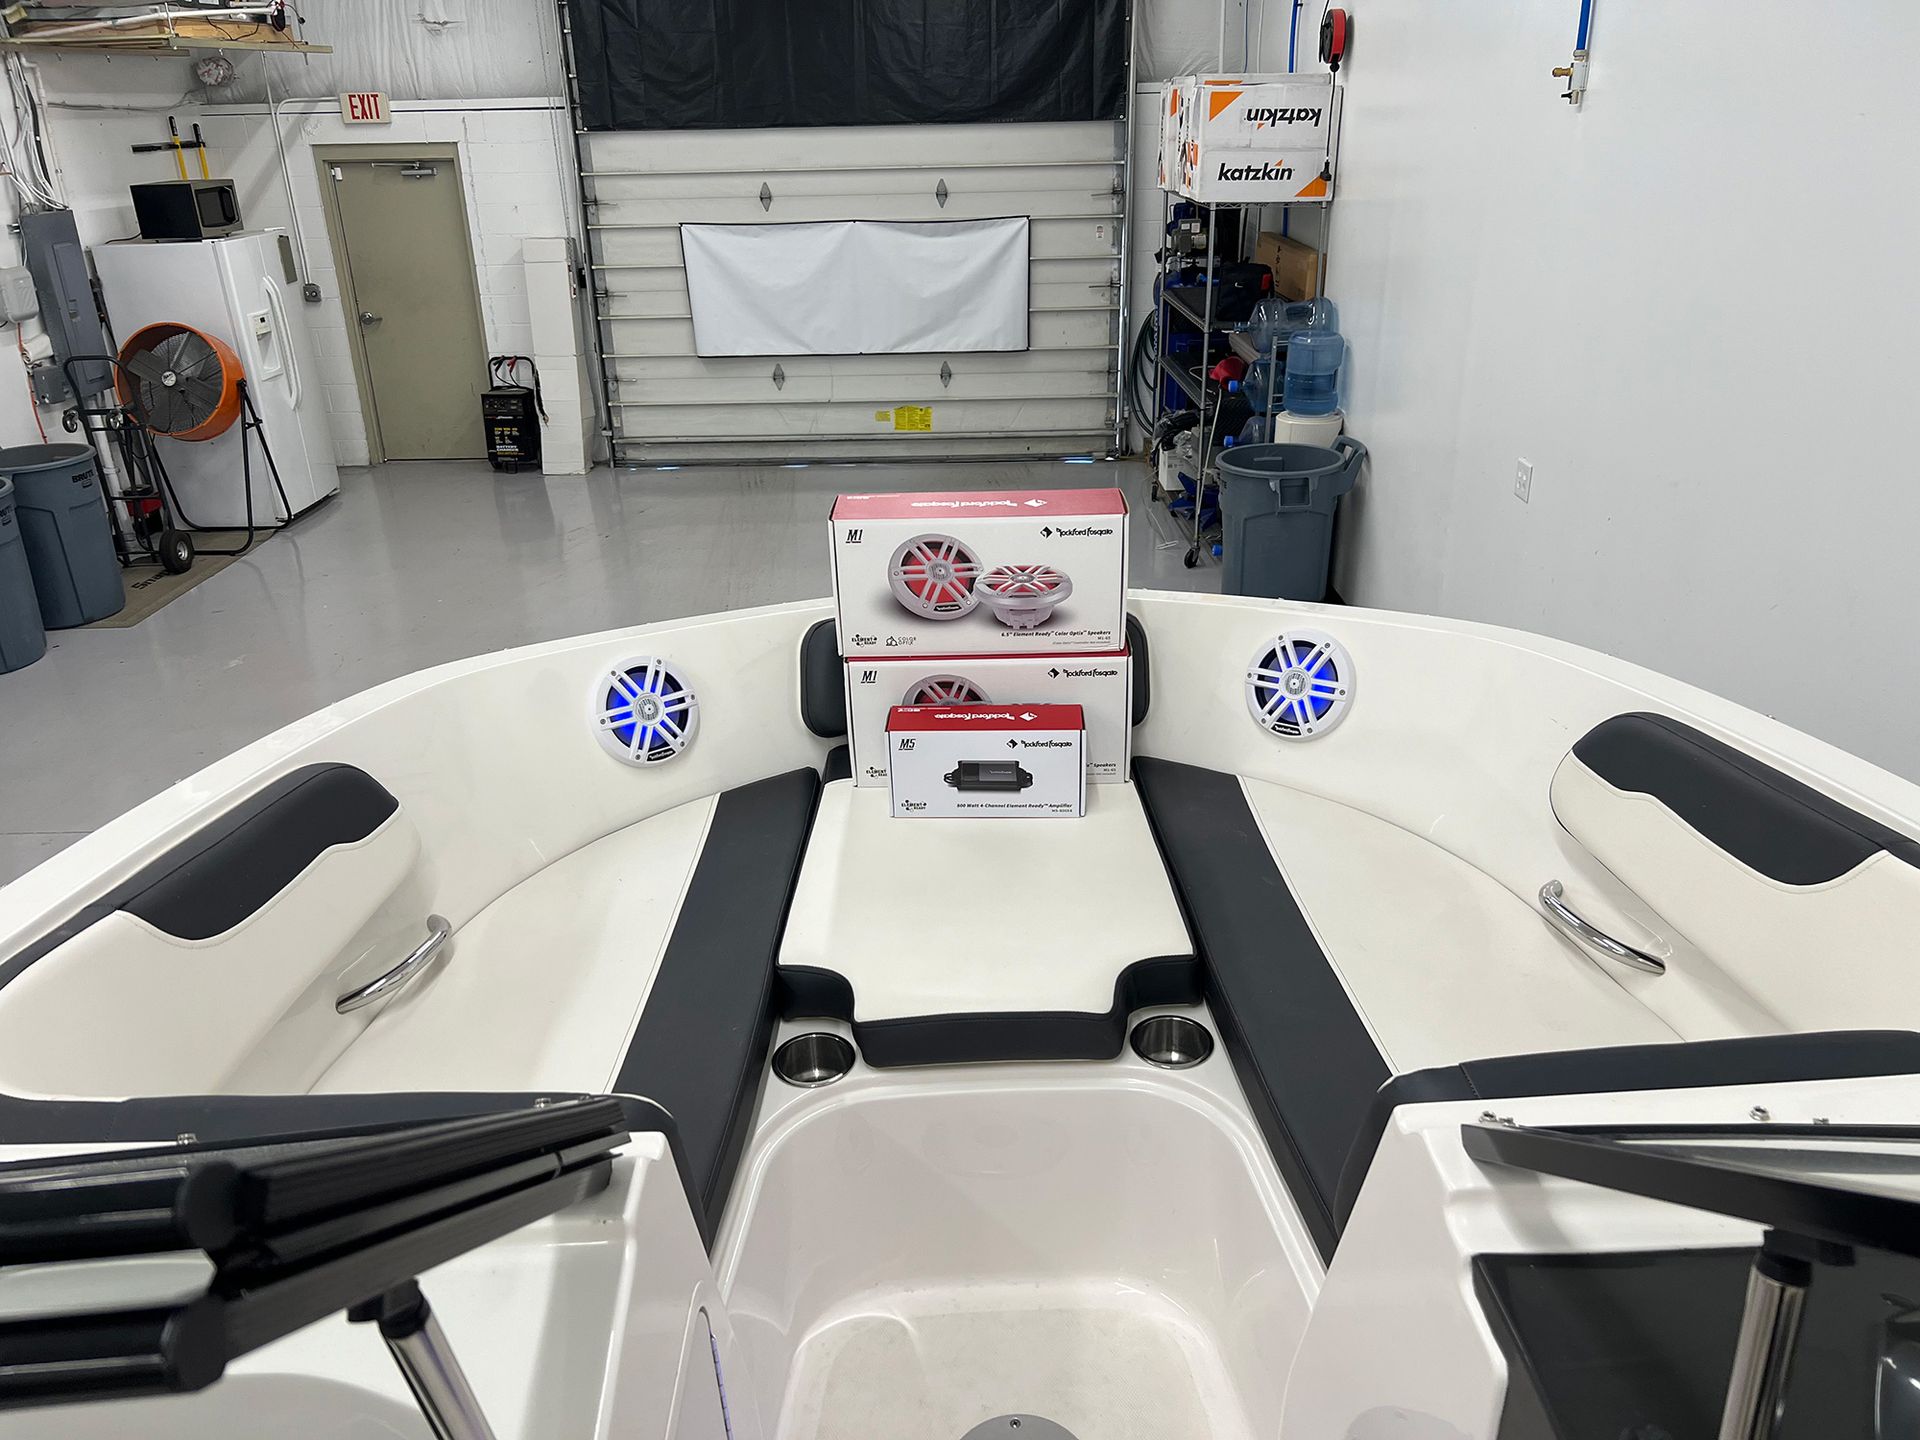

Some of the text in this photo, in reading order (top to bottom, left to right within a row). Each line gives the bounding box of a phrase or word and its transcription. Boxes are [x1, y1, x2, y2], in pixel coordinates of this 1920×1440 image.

[348, 94, 380, 119] EXIT
[1246, 108, 1322, 130] katzkin
[1217, 159, 1293, 181] katzkin
[846, 529, 863, 543] M1
[861, 671, 877, 683] M1
[899, 739, 916, 750] M5
